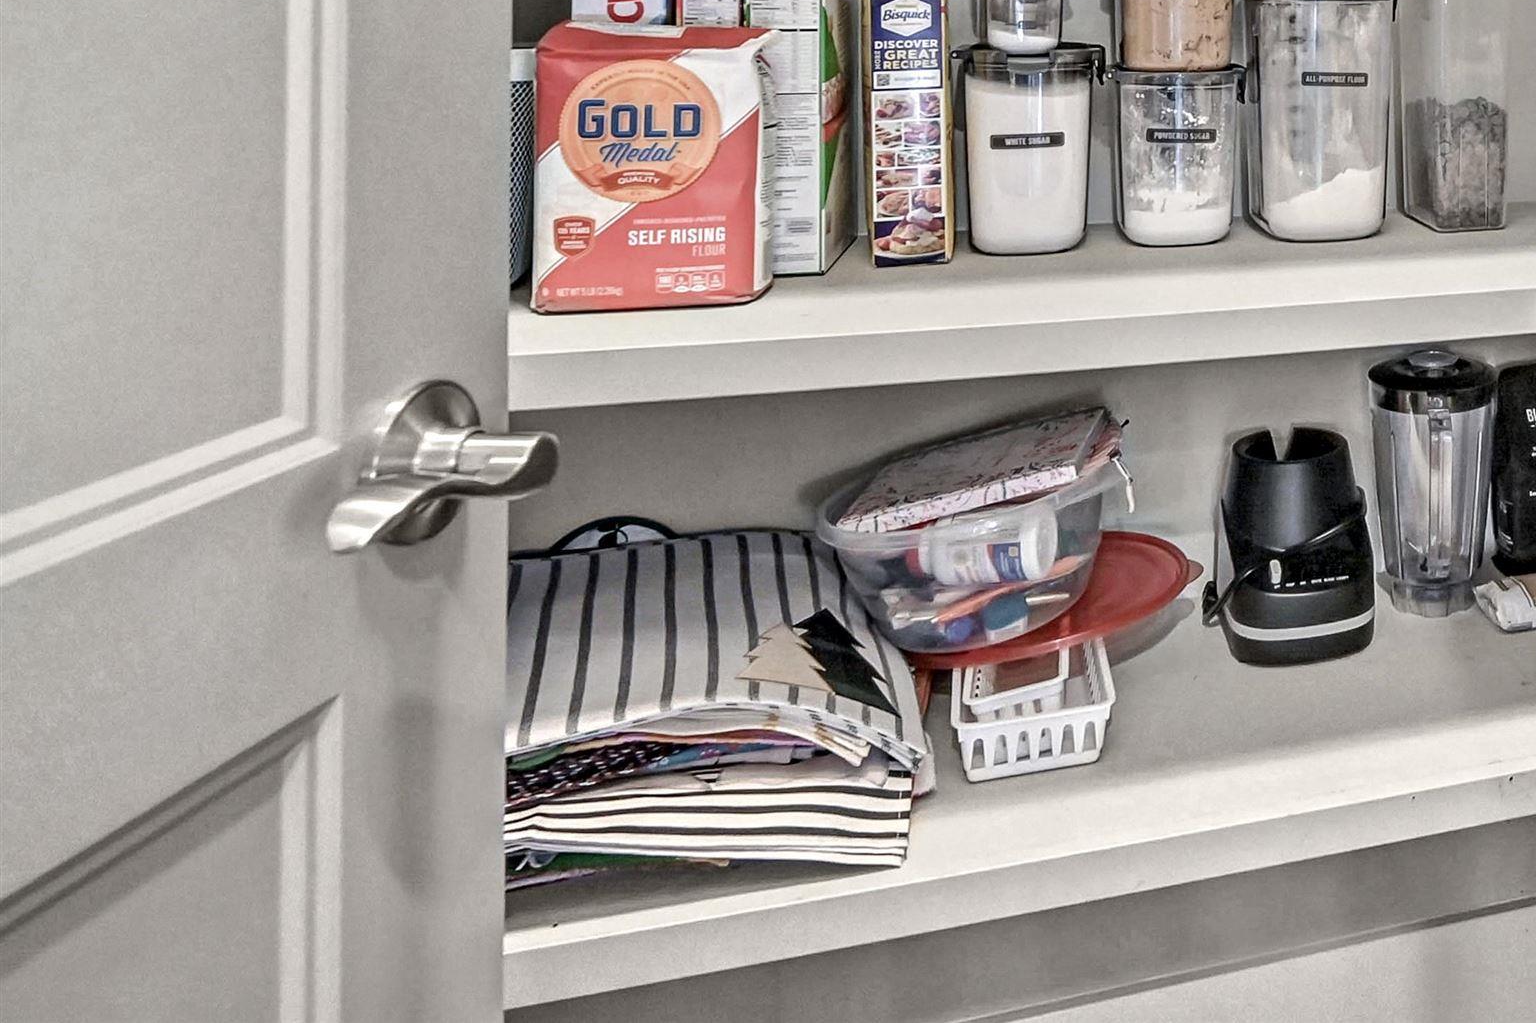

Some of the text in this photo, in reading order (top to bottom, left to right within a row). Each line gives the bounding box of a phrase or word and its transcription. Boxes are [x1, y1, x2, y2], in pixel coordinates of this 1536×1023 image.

[883, 9, 931, 22] Bisquick
[874, 39, 938, 50] DISCOVER
[884, 48, 939, 60] GREAT
[882, 59, 939, 70] RECIPES
[577, 98, 702, 139] GOLD
[600, 142, 679, 168] Medal
[617, 177, 661, 185] QUALITY
[628, 227, 726, 246] SELF RISING
[692, 245, 726, 257] FLOUR
